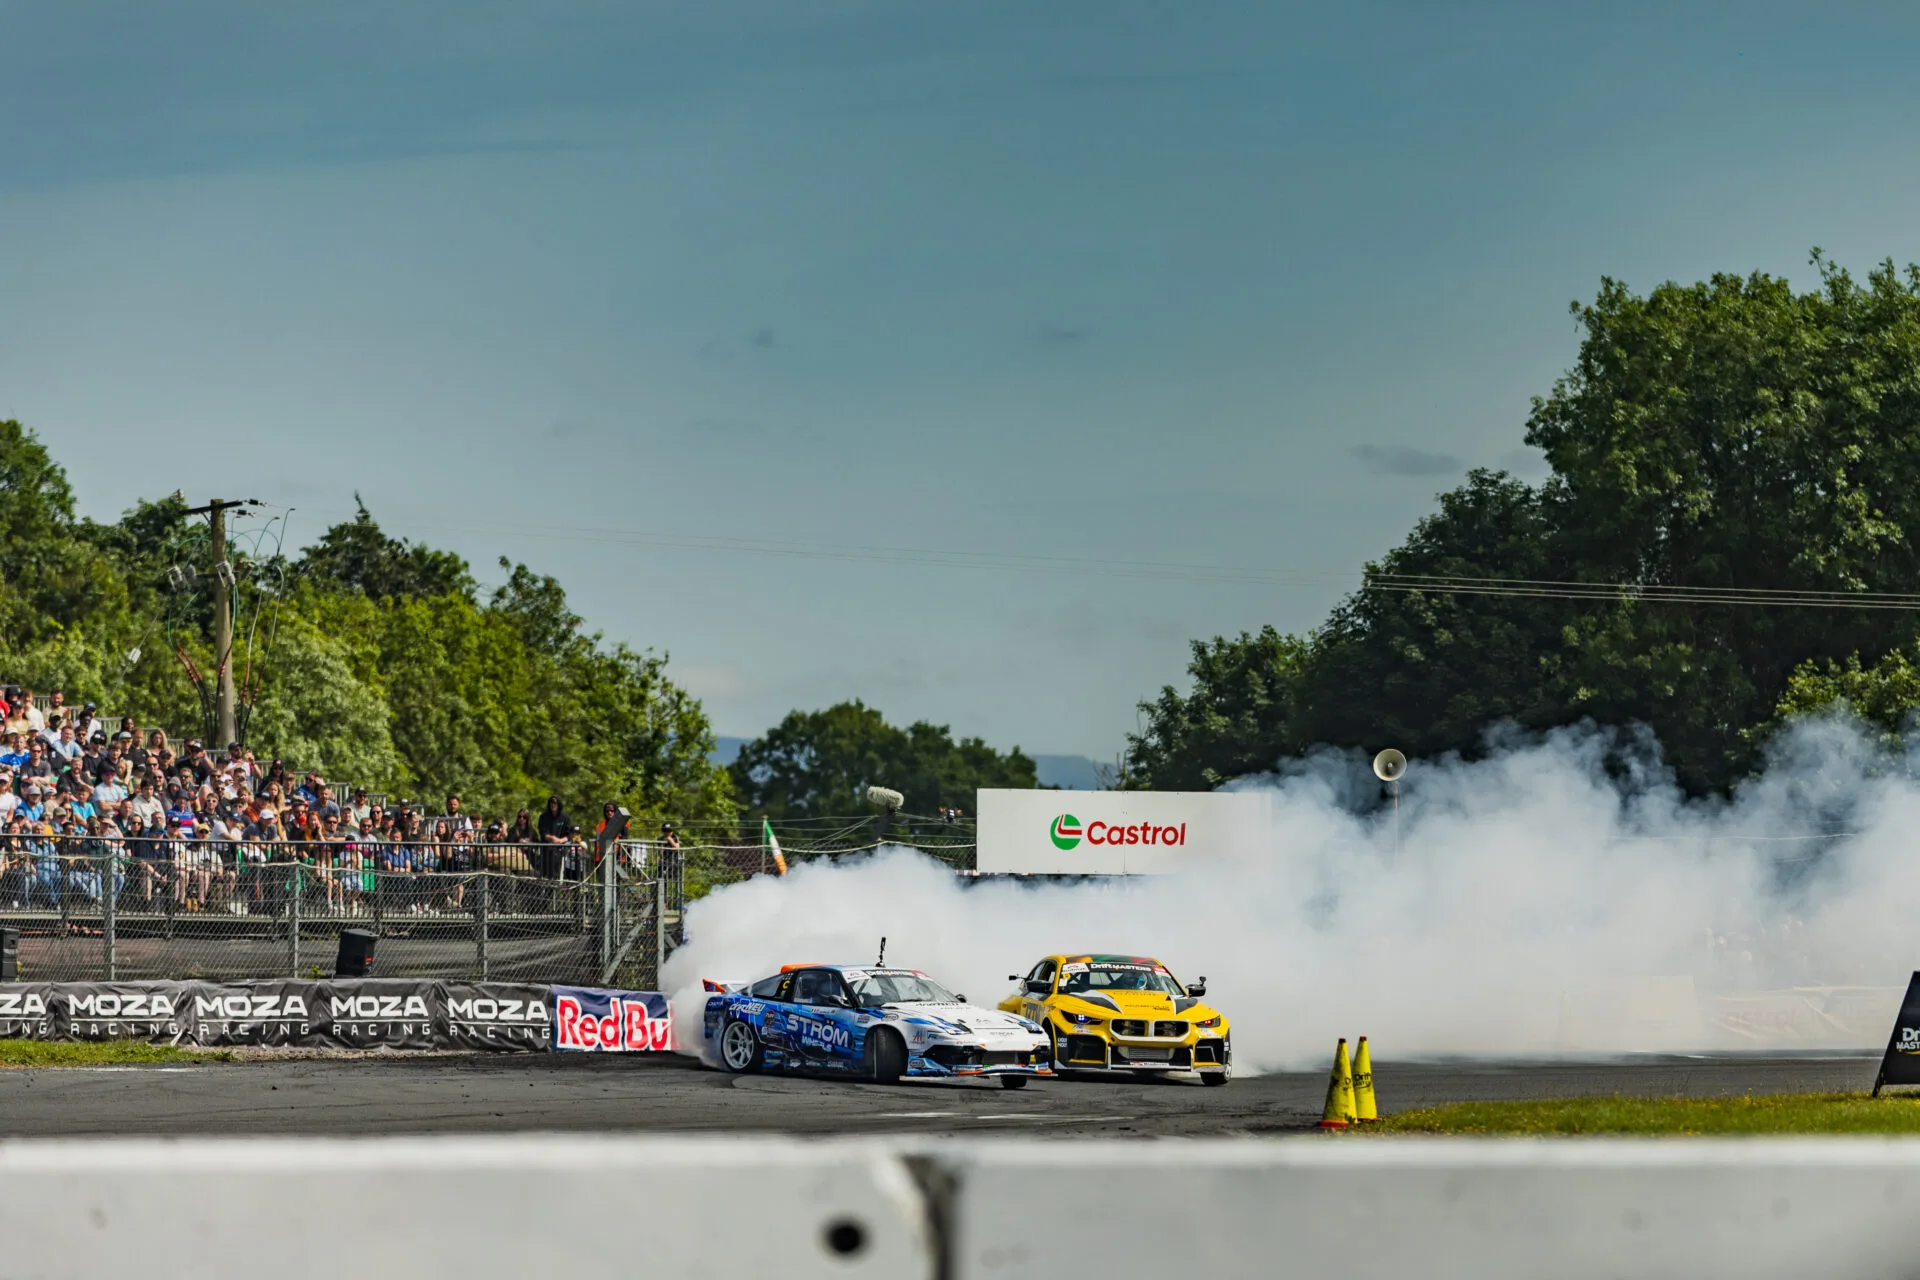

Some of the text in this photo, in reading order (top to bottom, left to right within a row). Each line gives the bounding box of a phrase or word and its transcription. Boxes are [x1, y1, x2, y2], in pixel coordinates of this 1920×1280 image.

[1087, 820, 1187, 846] Castrol
[0, 994, 46, 1015] ZA
[68, 994, 175, 1016] MOZA
[195, 995, 308, 1017] MOZA
[331, 996, 429, 1017] MOZA
[448, 998, 549, 1020] MOZA
[7, 1022, 47, 1034] ING
[70, 1023, 179, 1036] RACING
[200, 1024, 309, 1036] RACING
[332, 1024, 430, 1036] RACING
[449, 1025, 550, 1040] RACING
[557, 996, 622, 1048] Red
[786, 1013, 848, 1047] STRÖM
[1896, 1041, 1920, 1050] MAST
